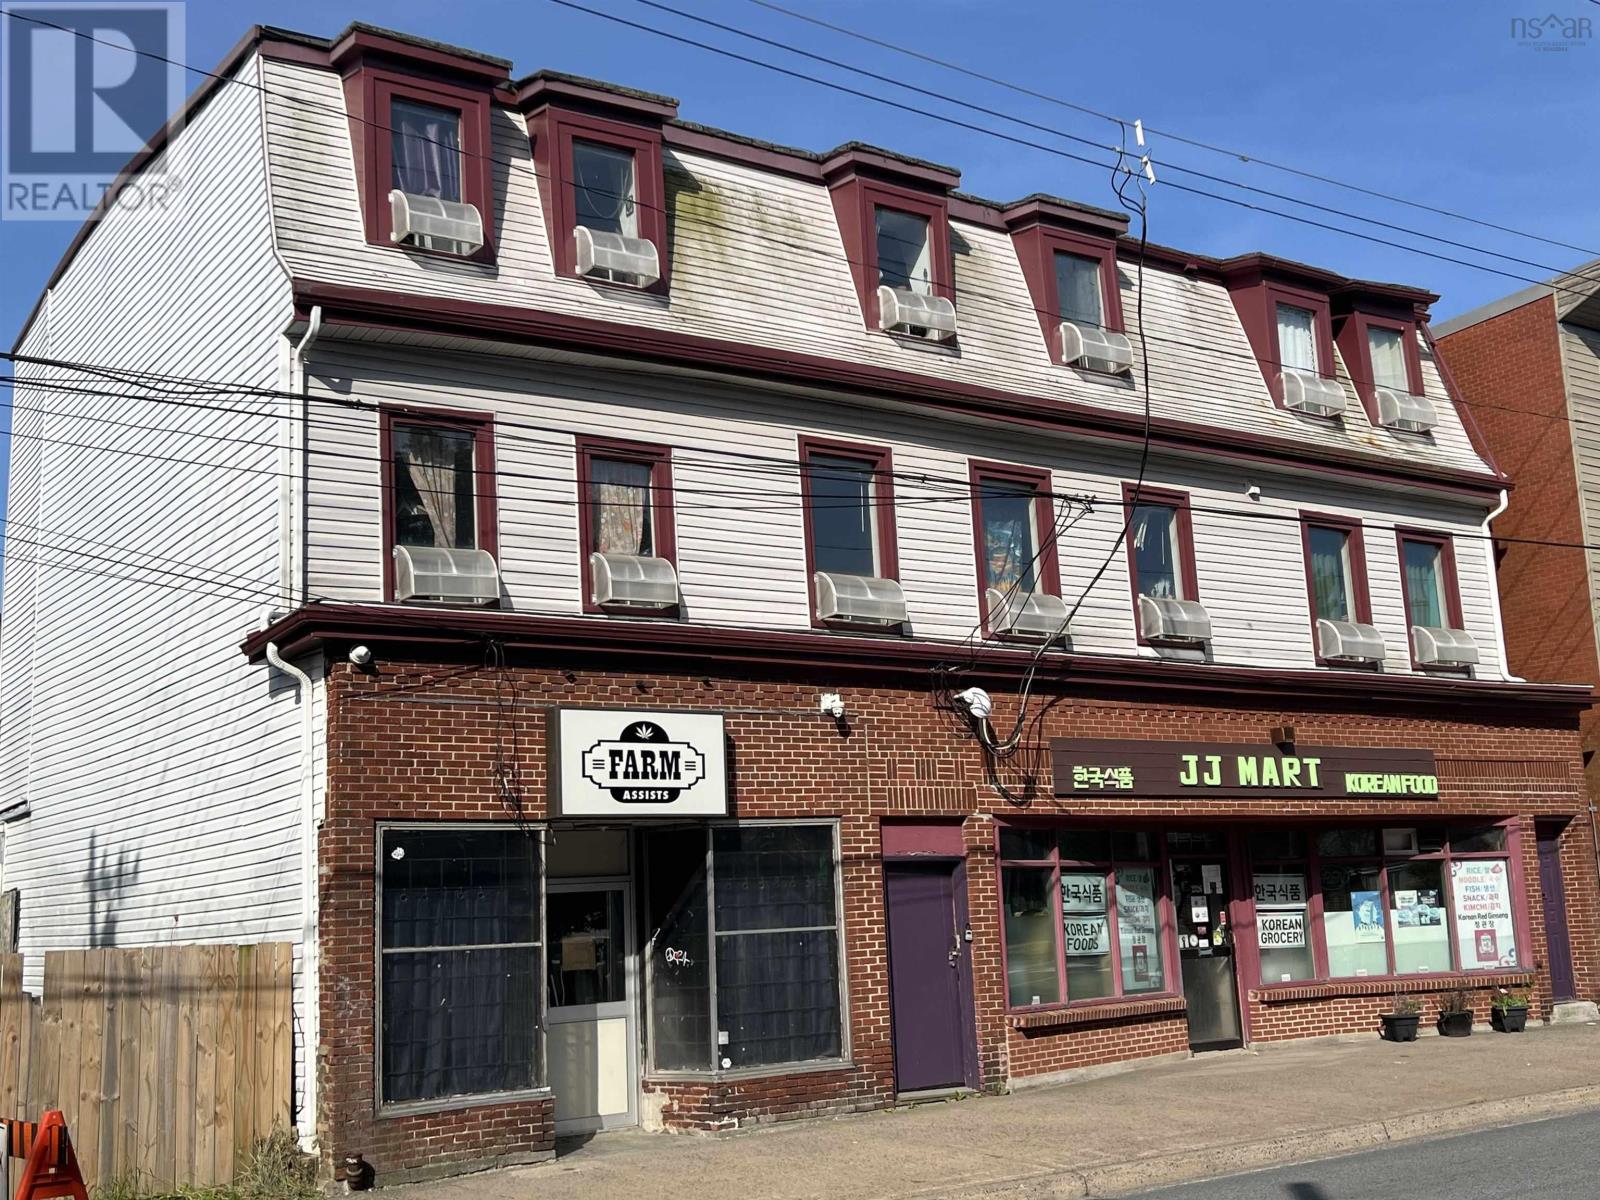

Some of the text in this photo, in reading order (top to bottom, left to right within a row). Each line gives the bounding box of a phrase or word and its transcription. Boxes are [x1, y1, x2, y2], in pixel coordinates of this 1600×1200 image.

[608, 749, 681, 780] FARM
[1072, 766, 1134, 789] 한국식품
[1237, 756, 1321, 787] MART
[623, 790, 669, 800] ASSISTS
[1063, 922, 1104, 936] KOREAN
[1261, 919, 1302, 930] KOREAN
[1066, 937, 1099, 950] FOODS
[1260, 931, 1303, 943] GROCERY
